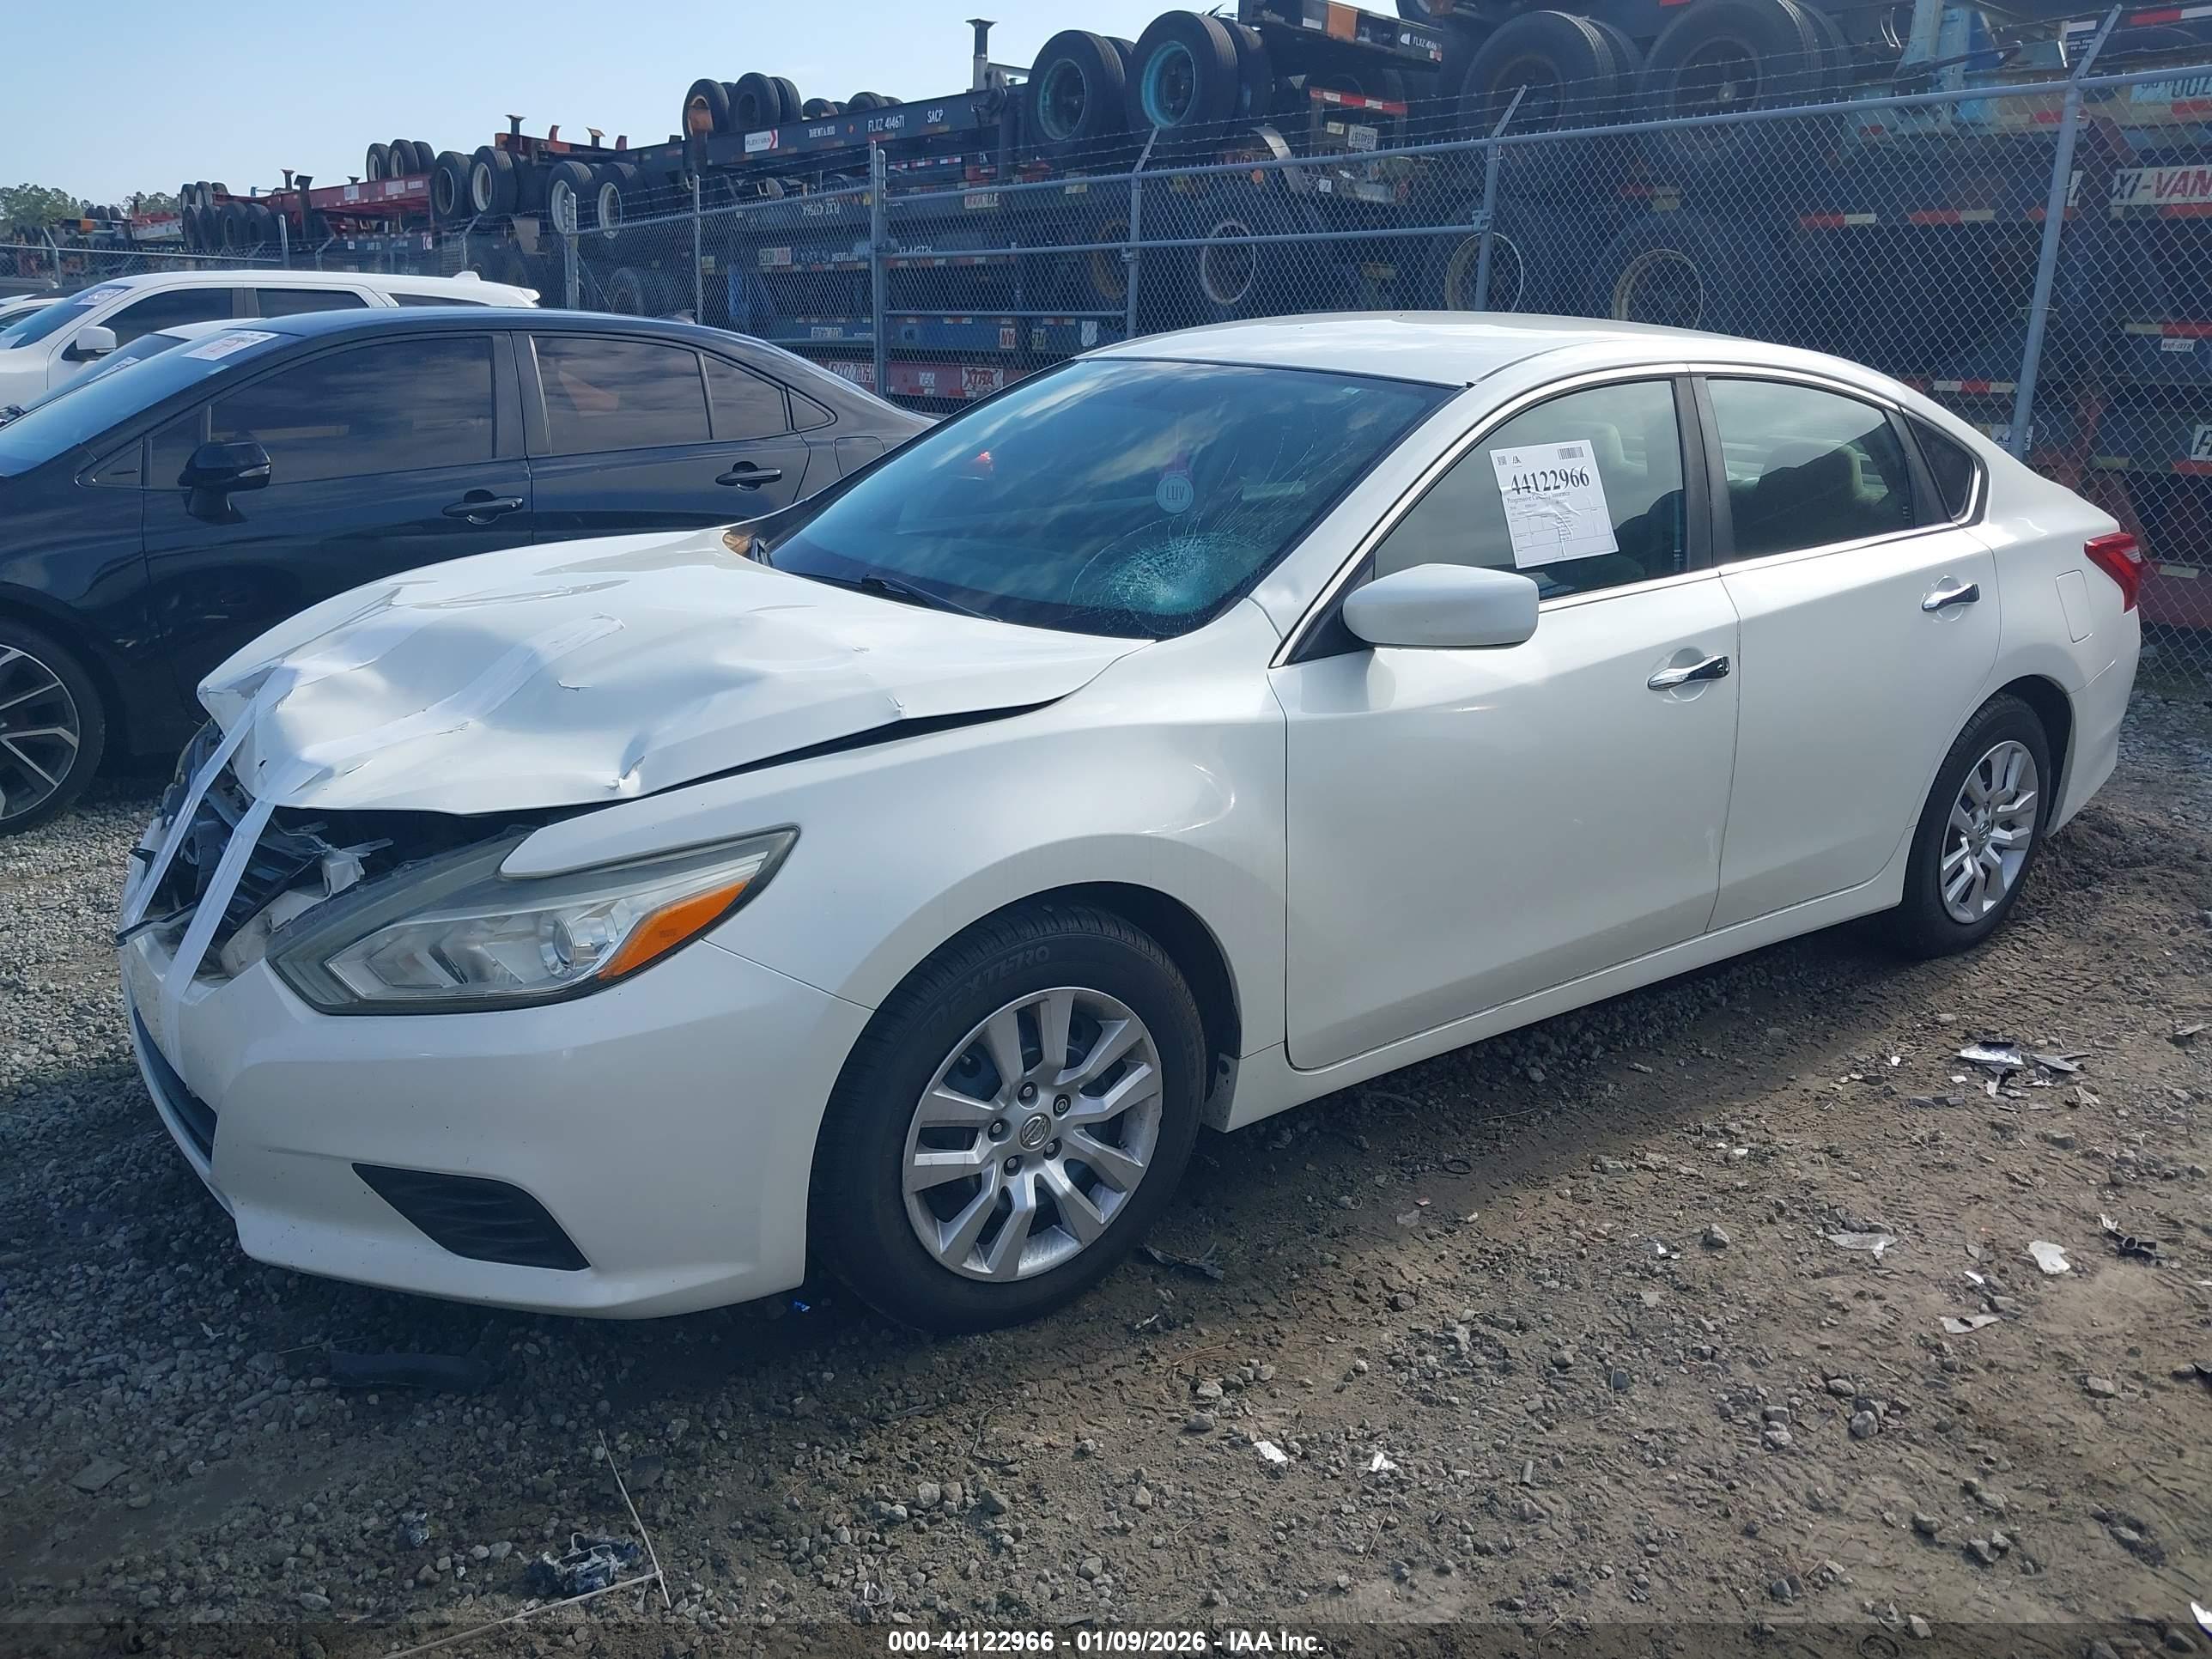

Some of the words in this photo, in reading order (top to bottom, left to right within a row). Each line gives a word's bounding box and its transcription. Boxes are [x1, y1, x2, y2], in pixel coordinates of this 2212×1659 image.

[868, 118, 883, 132] FLXZ
[885, 114, 905, 130] 414671
[927, 109, 944, 124] SACP
[2111, 170, 2212, 199] XI-VAN
[1510, 465, 1590, 495] 44122966
[1165, 486, 1185, 501] LUV
